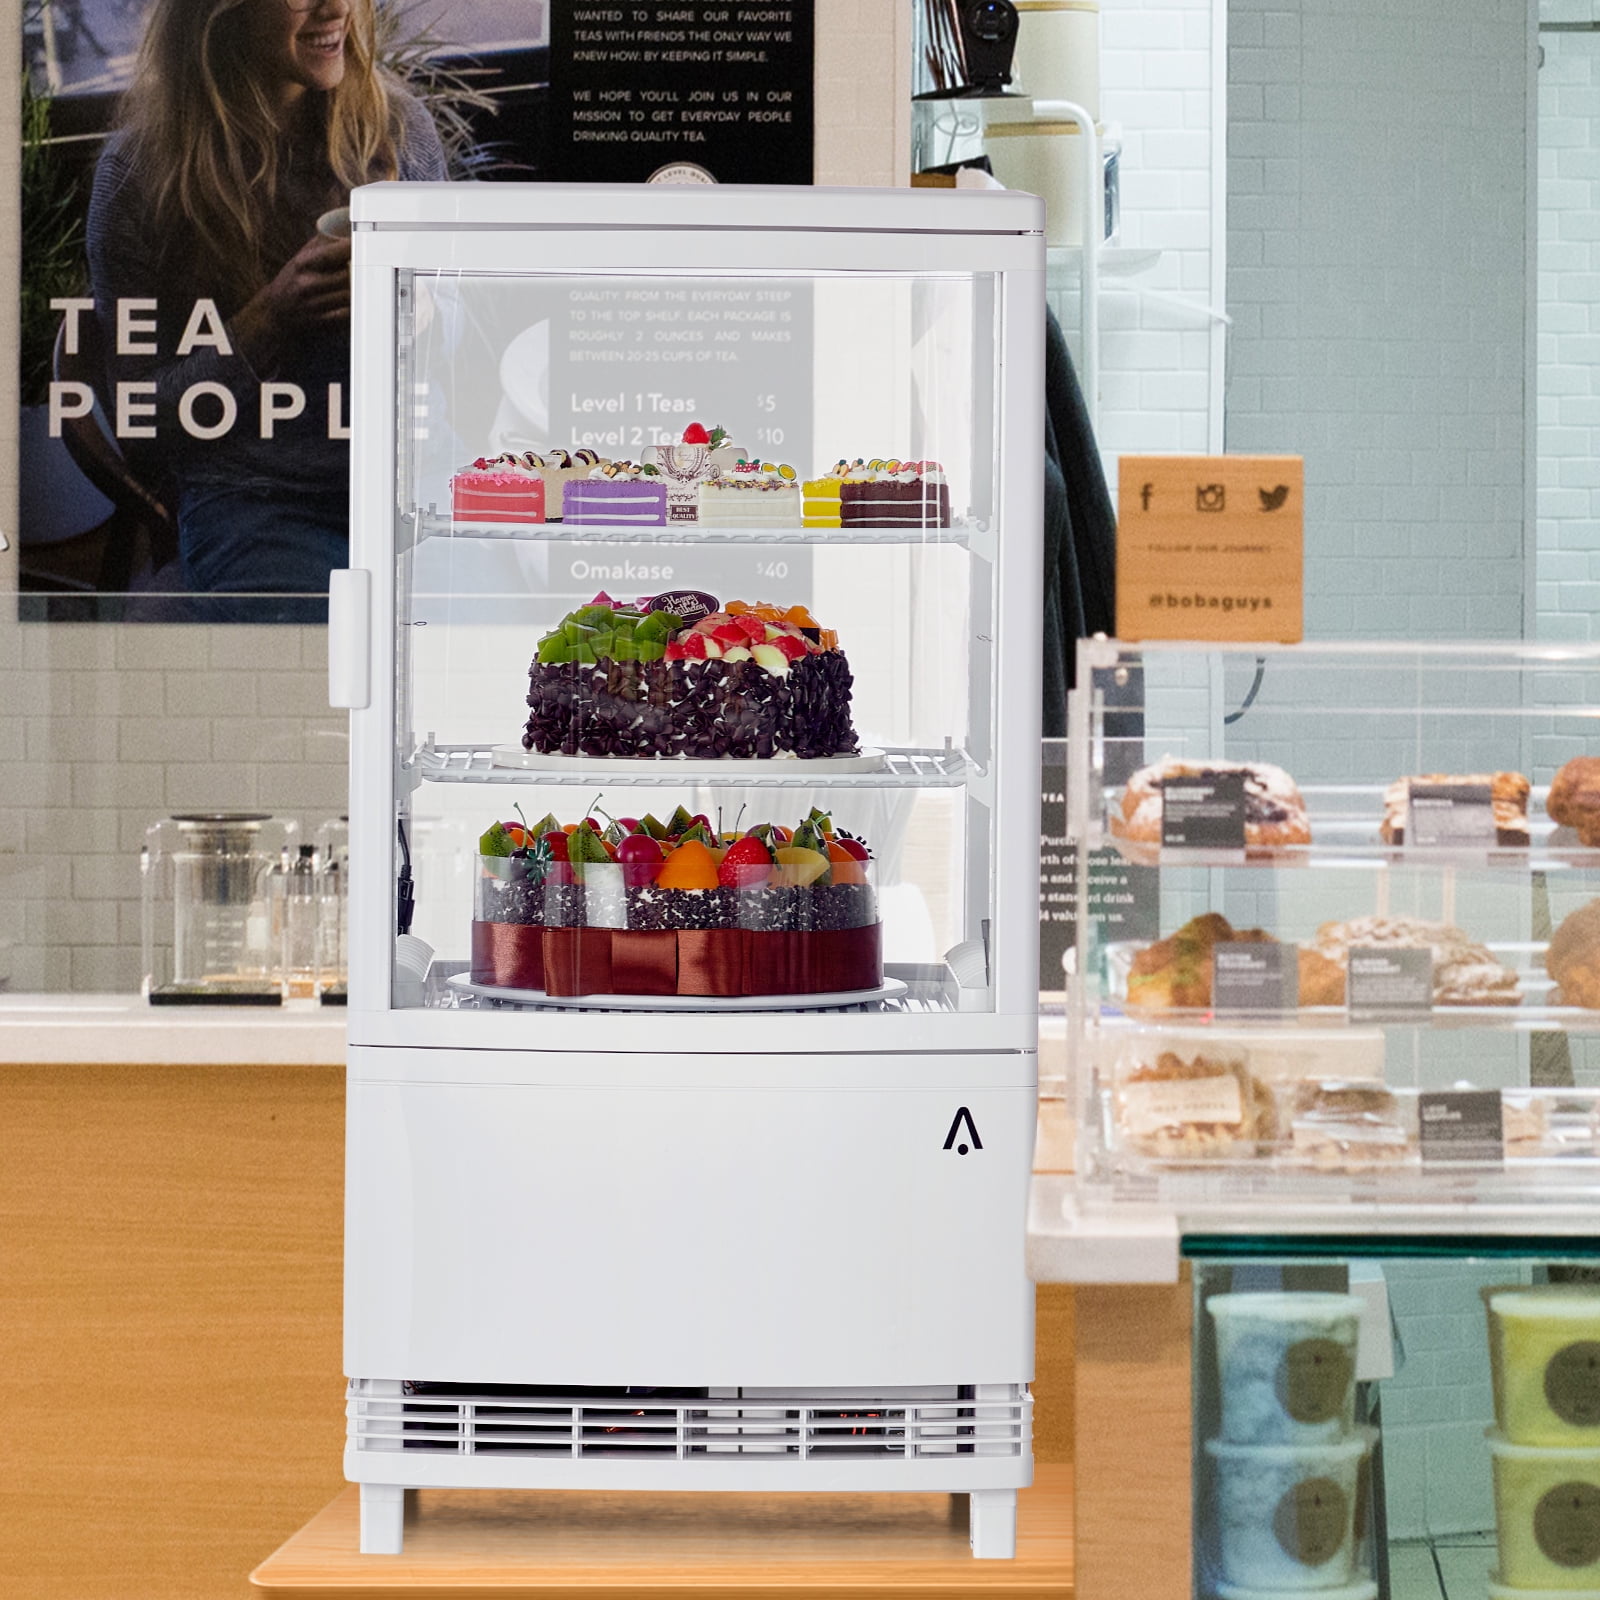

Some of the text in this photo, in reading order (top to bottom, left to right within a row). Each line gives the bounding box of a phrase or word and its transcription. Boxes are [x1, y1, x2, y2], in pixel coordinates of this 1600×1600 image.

[573, 10, 793, 23] WANTED TO SHARE OUR FAVORITE
[573, 30, 793, 43] TEAS WITH FRIENDS THE ONLY WAY WE
[572, 50, 608, 63] KNEW
[643, 50, 658, 63] BY
[660, 50, 711, 63] KEEPING
[712, 50, 723, 63] IT
[572, 90, 793, 103] WE HOPE YOU'LL JOIN US IN OUR
[572, 110, 793, 123] MISSION TO GET EVERYDAY PEOPLE
[572, 130, 629, 143] DRINKING
[630, 130, 680, 143] QUALITY
[625, 290, 660, 303] FROM
[664, 290, 687, 303] THE
[691, 290, 752, 303] EVERYDAY
[755, 290, 793, 303] STEEP
[569, 310, 586, 323] TO
[590, 310, 612, 323] THE
[618, 310, 642, 323] TOP
[687, 310, 720, 323] EACH
[723, 310, 776, 323] PACKAGE
[779, 310, 793, 323] IS
[50, 298, 234, 356] TEA
[569, 330, 793, 343] ROUGHLY 2 OUNCES AND MAKES
[569, 350, 625, 363] BETWEEN
[661, 350, 694, 363] CUPS
[695, 350, 713, 363] OF
[571, 392, 776, 413] Level 1 Teas $5
[571, 425, 785, 446] Level 2 Tea $10
[570, 559, 789, 580] Omakase $40
[661, 594, 699, 609] Happy
[1102, 893, 1135, 904] drink
